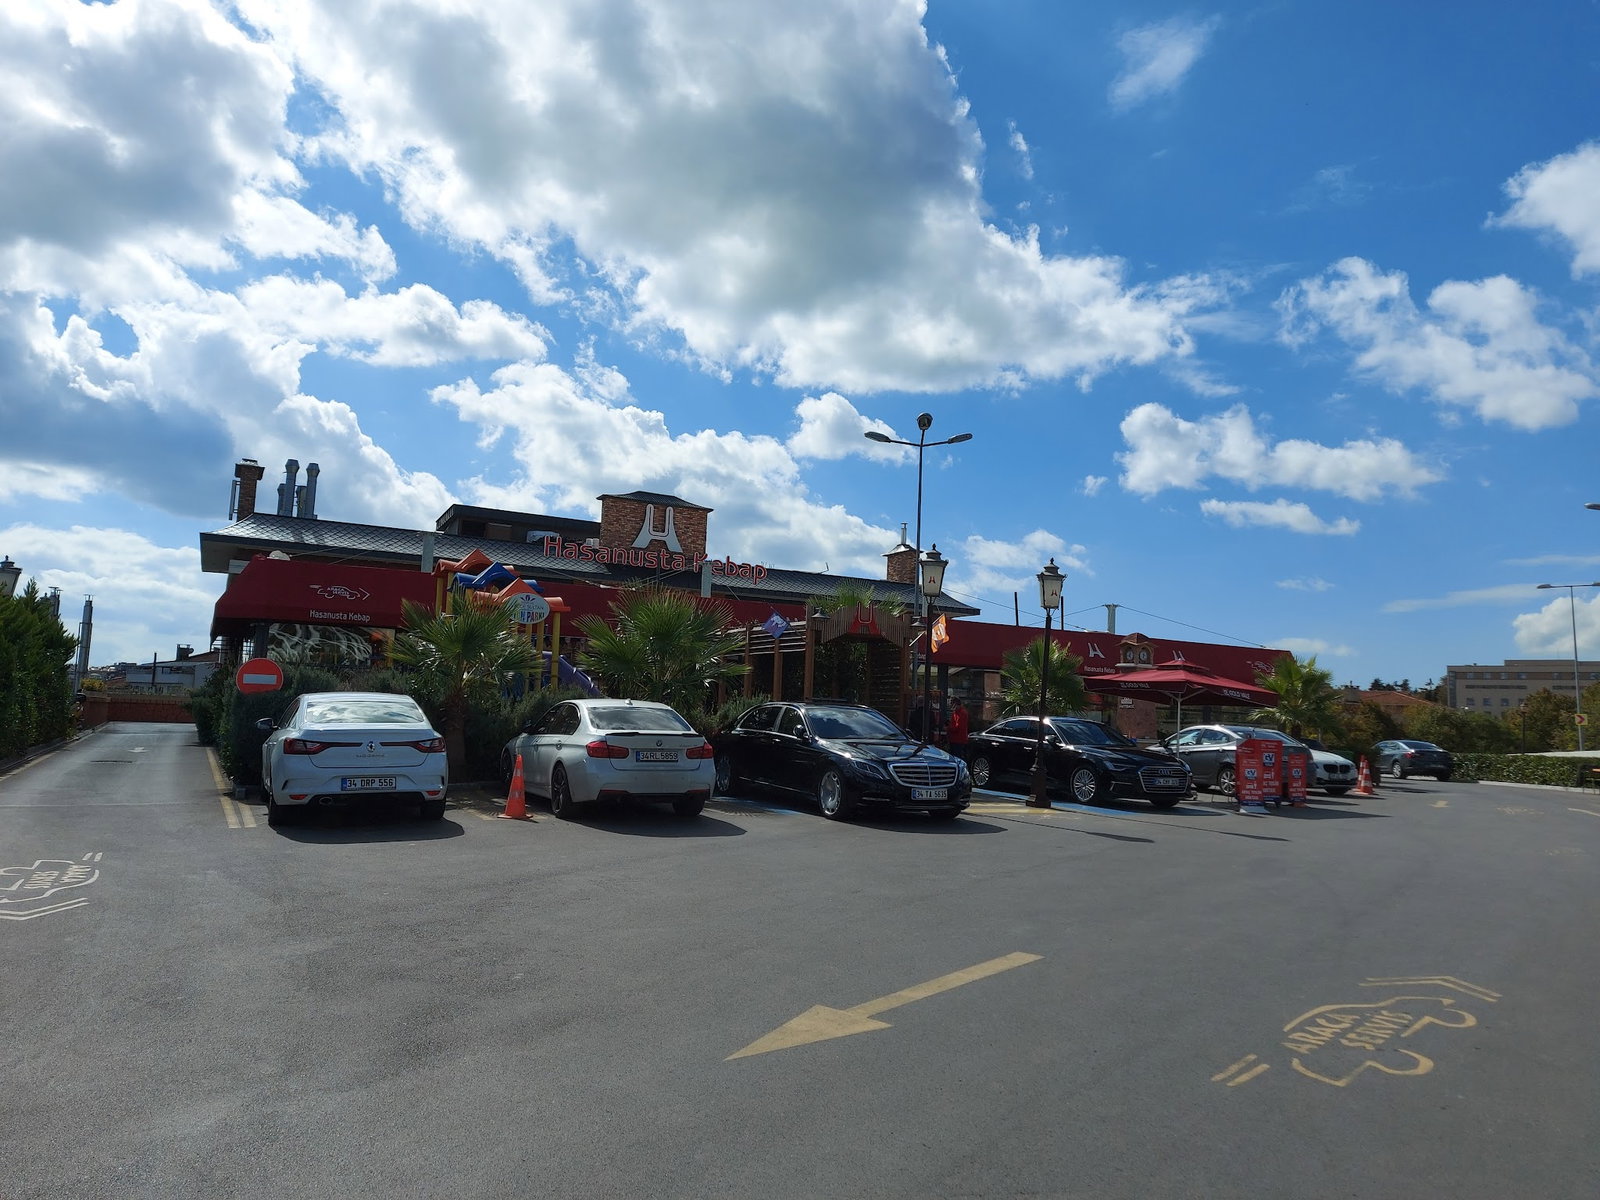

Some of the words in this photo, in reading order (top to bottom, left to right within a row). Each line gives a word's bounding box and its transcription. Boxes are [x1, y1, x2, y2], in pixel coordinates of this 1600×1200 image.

[543, 535, 686, 571] Hasanusta
[692, 552, 768, 585] Kebap
[309, 609, 348, 620] Hasanusta
[348, 612, 371, 623] Kebap
[347, 779, 357, 787] 34
[378, 778, 394, 787] 556
[916, 790, 924, 798] 34
[1282, 1012, 1360, 1054] ARACA
